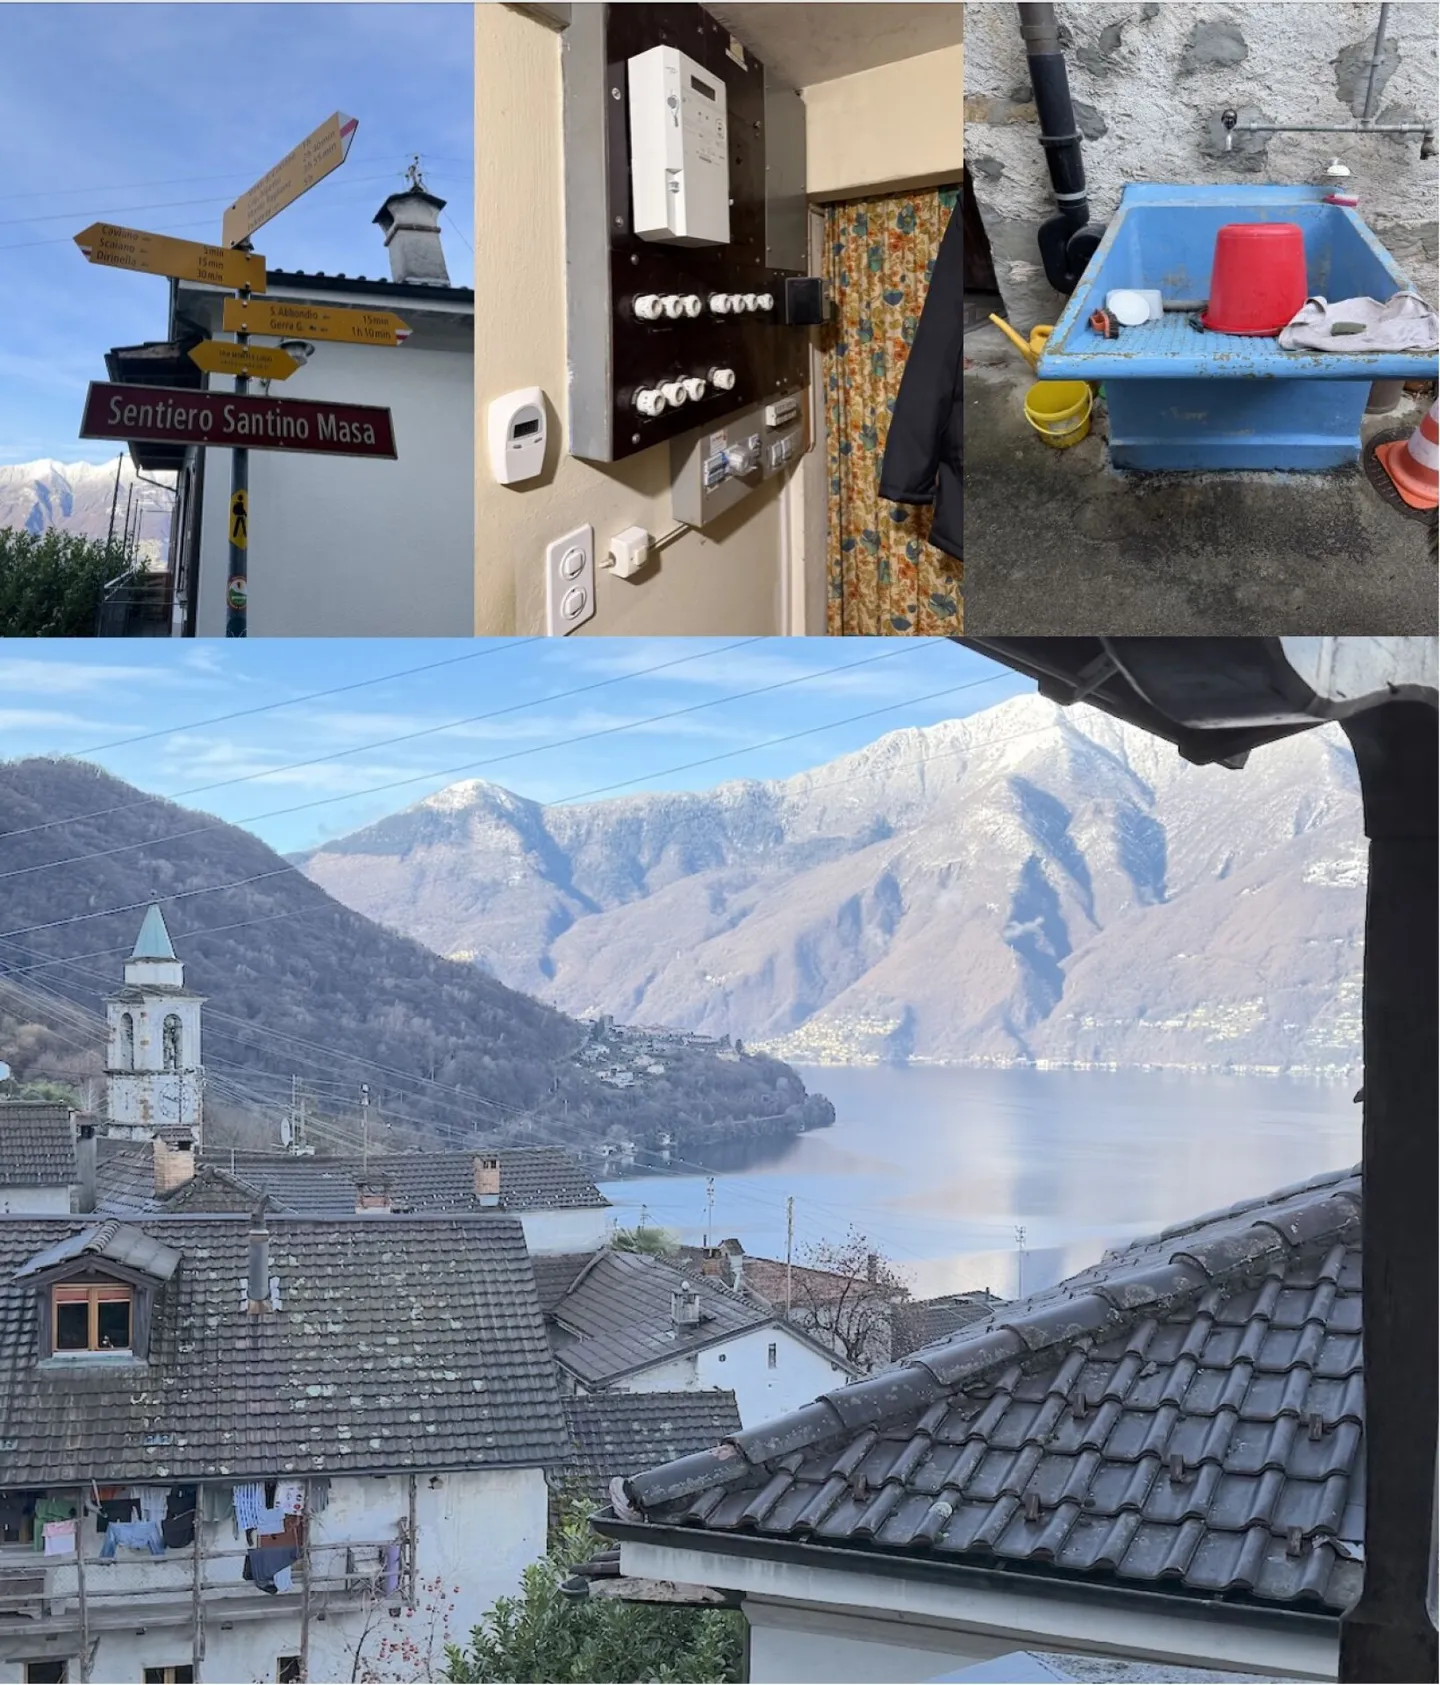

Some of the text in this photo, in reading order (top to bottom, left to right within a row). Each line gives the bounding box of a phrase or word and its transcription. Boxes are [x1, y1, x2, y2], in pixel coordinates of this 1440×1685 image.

[102, 225, 139, 240] Caviano
[99, 238, 136, 253] Scaiano
[96, 250, 137, 267] Dirinella
[270, 319, 293, 330] Gerra
[107, 396, 377, 444] Sentiero Santino Masa
